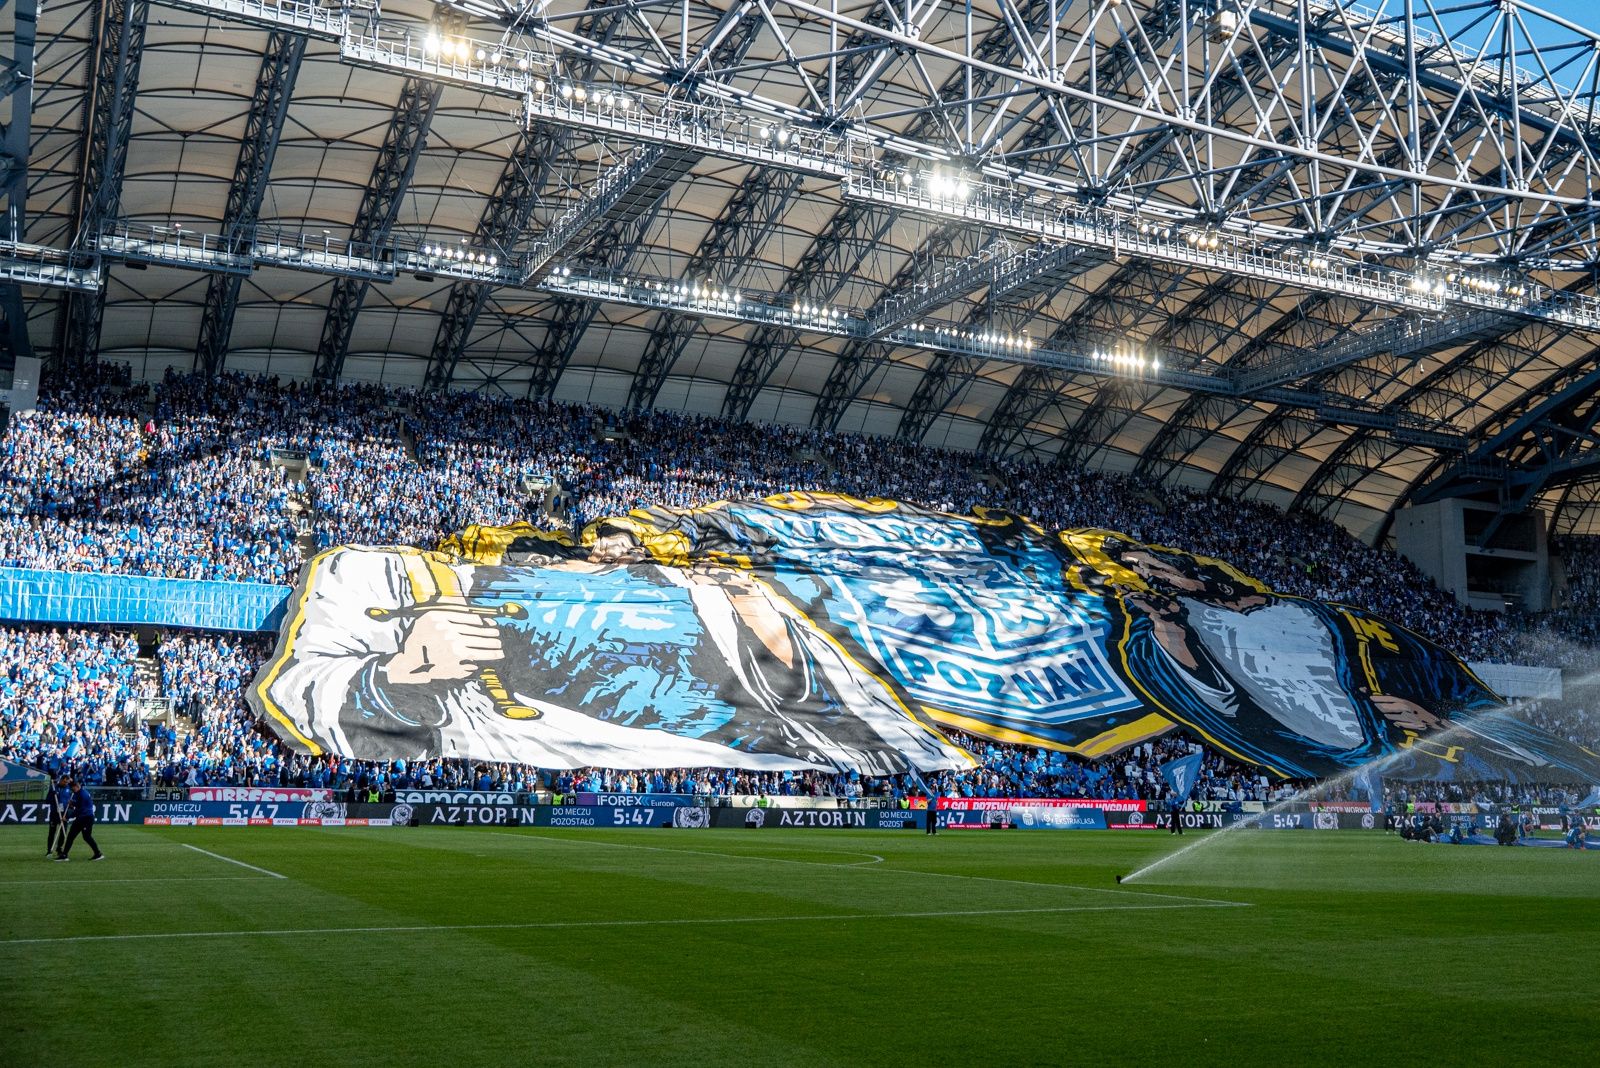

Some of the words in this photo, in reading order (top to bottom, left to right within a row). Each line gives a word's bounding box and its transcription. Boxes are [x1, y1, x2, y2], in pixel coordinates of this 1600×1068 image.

[896, 648, 1096, 706] POZNAŃ
[395, 792, 513, 804] semcore
[597, 795, 642, 806] iFOREX
[0, 804, 132, 822] AZTIN
[153, 804, 167, 812] DO
[169, 804, 201, 812] MECZU
[229, 804, 279, 819] 5:47
[553, 808, 564, 816] DO
[565, 808, 591, 816] MECZU
[431, 807, 535, 824] AZTORIN
[551, 817, 595, 826] POZOSTAŁO
[613, 808, 654, 825] 5:47
[780, 811, 866, 826] AZTORIN
[1273, 814, 1301, 828] 5:47
[879, 820, 904, 828] POZOST
